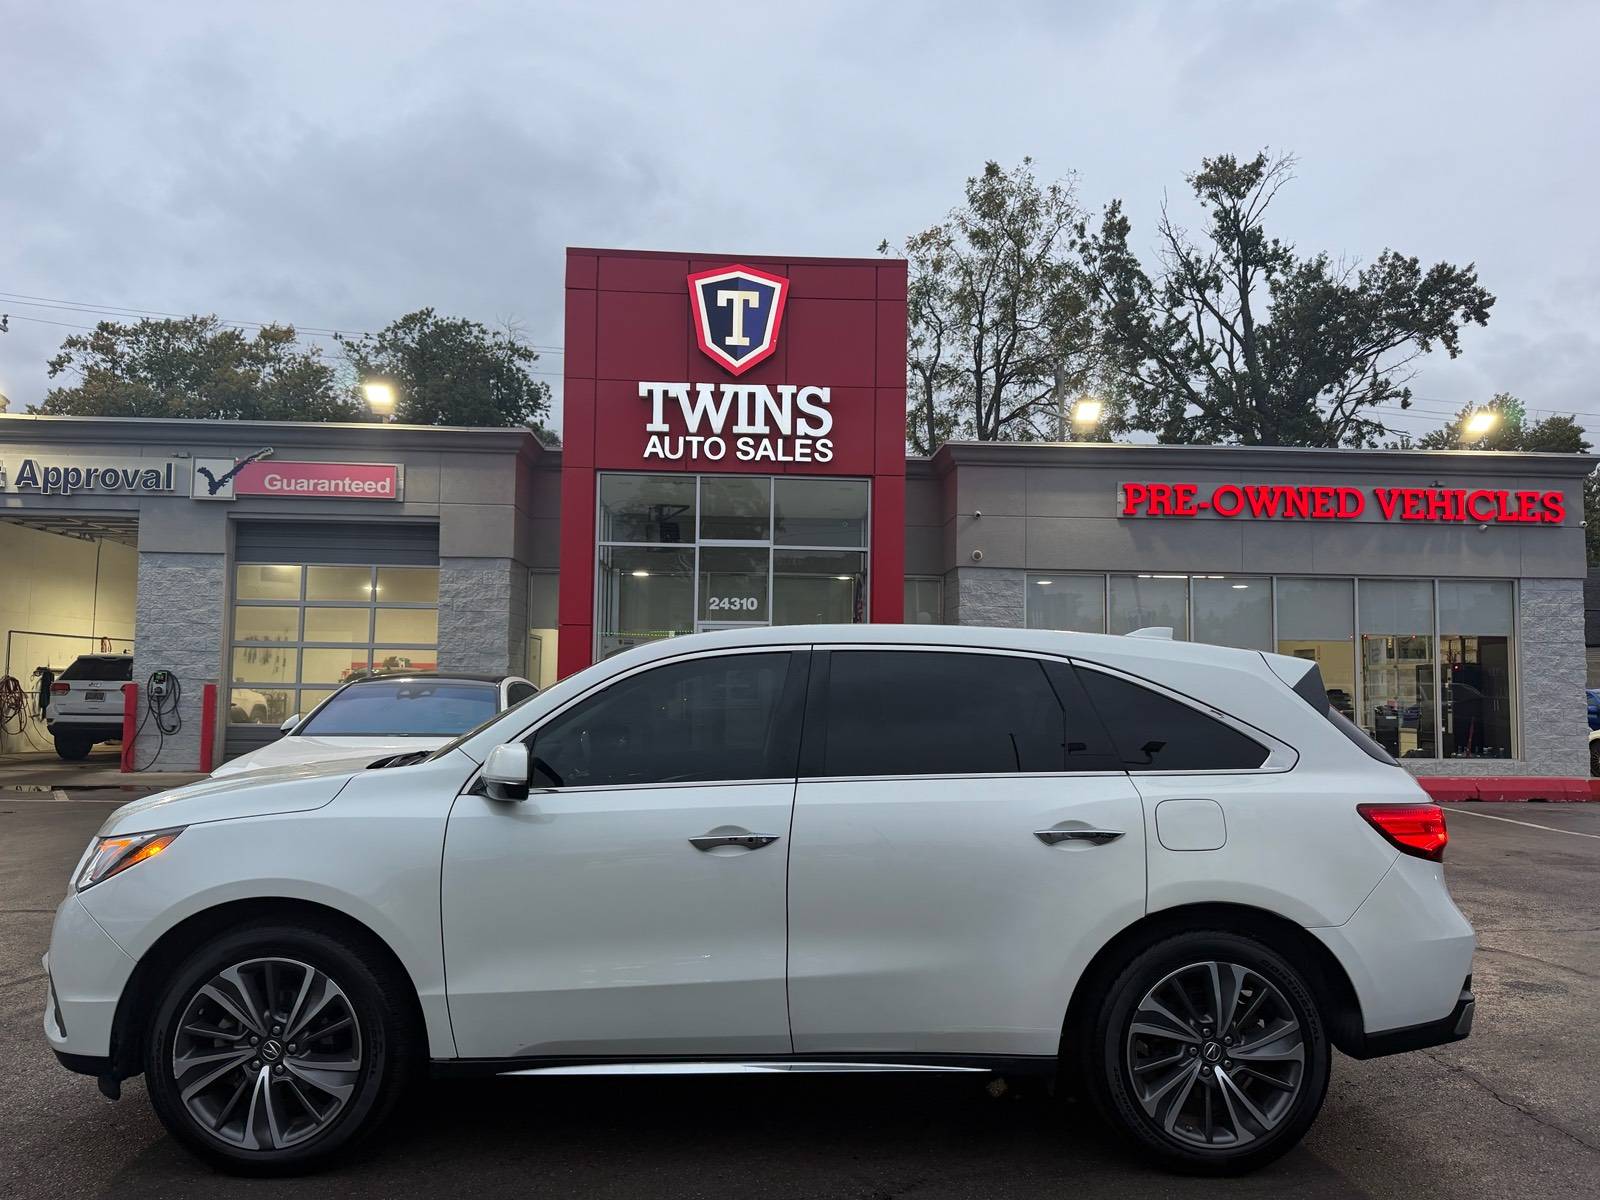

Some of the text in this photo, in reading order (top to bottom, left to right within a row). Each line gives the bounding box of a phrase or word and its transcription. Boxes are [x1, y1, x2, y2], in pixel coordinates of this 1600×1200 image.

[717, 289, 760, 346] T
[638, 381, 833, 437] TWINS
[643, 435, 834, 462] AUTO SALES
[14, 458, 175, 495] Approval
[263, 473, 391, 494] Guaranteed
[1122, 483, 1567, 523] PRE-OWNED VEHICLES
[709, 596, 758, 611] 24310
